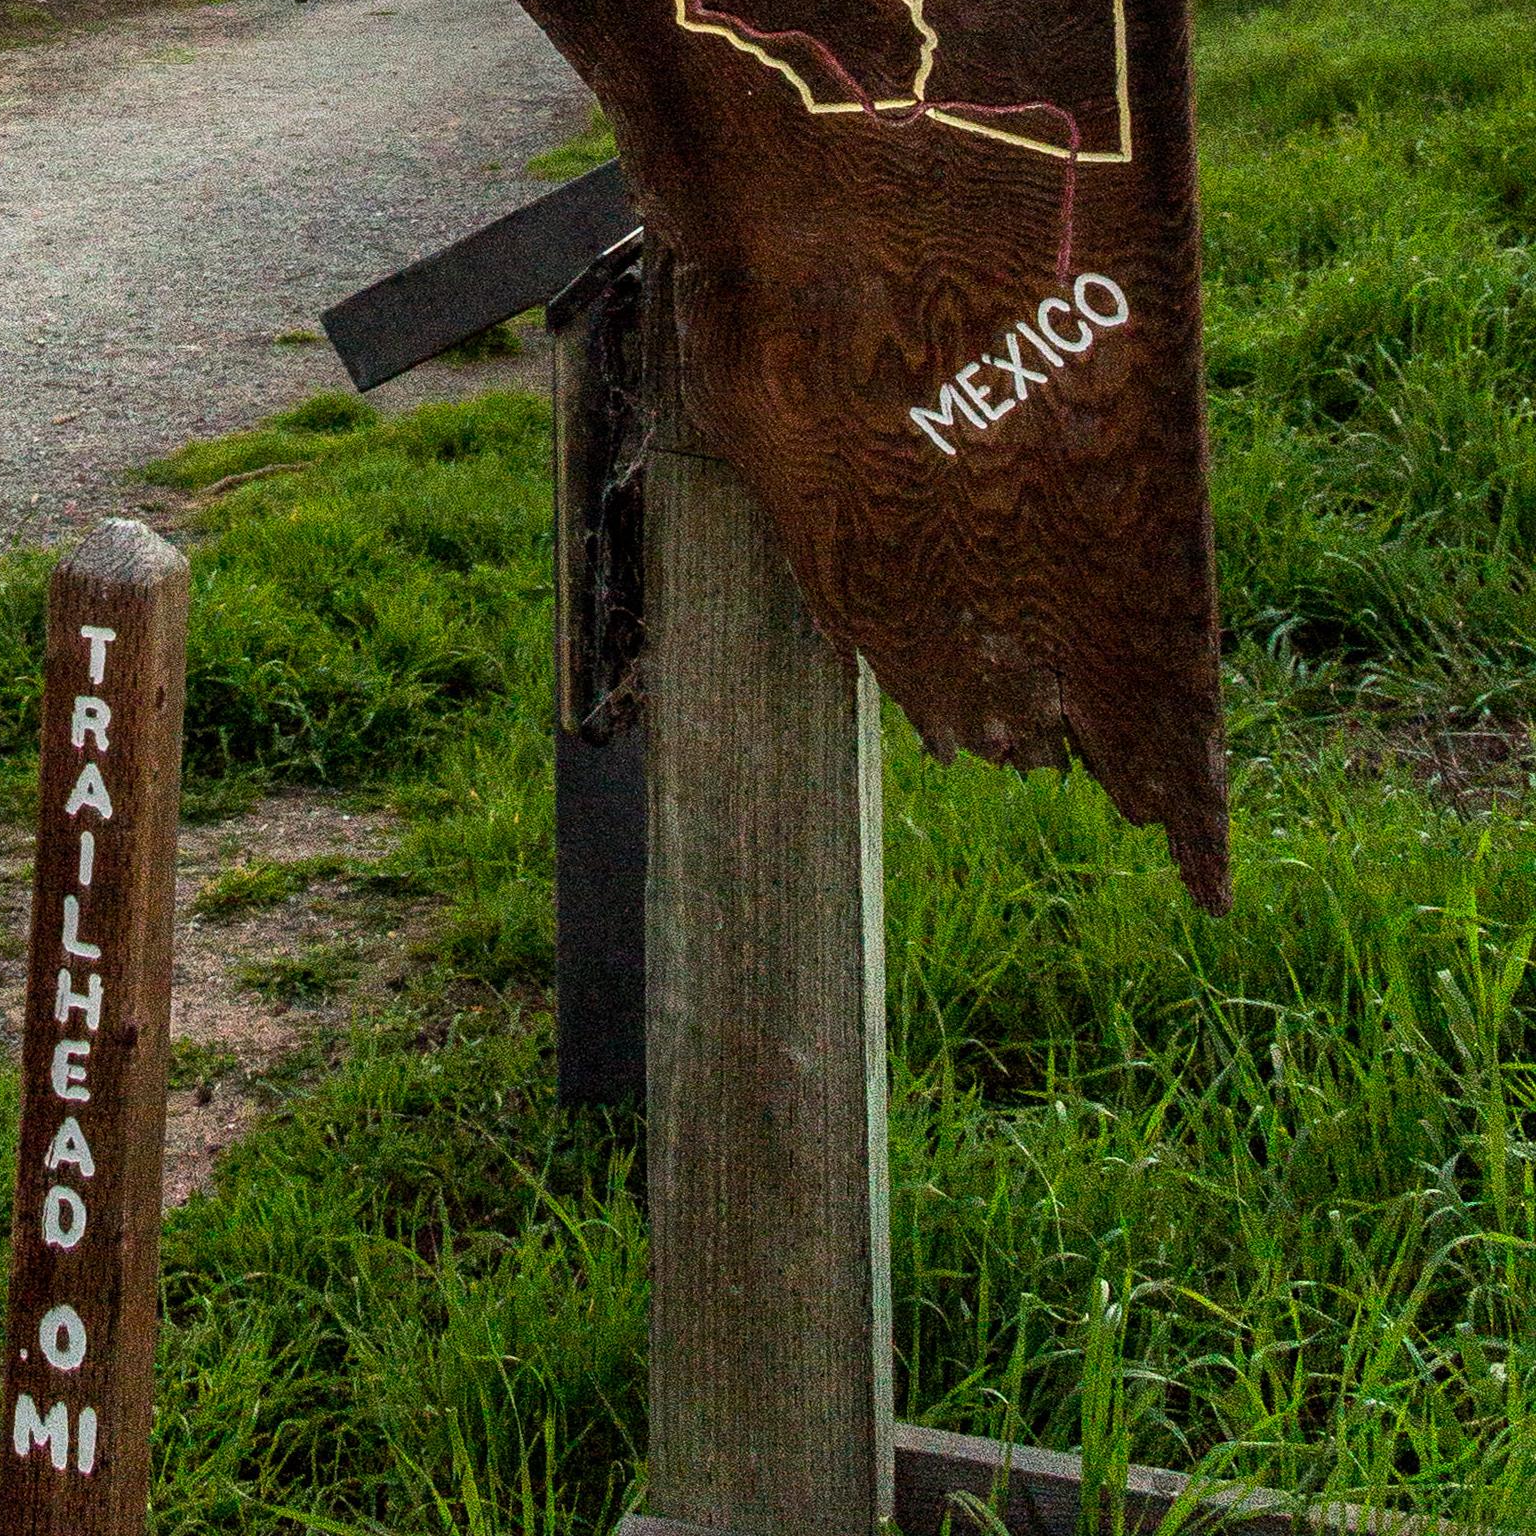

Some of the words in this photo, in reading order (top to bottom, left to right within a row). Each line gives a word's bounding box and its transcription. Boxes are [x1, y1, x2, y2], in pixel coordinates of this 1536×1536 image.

[909, 272, 1131, 457] MEXICO
[42, 626, 116, 1250] TRAILHEAD
[13, 1394, 97, 1475] MI
